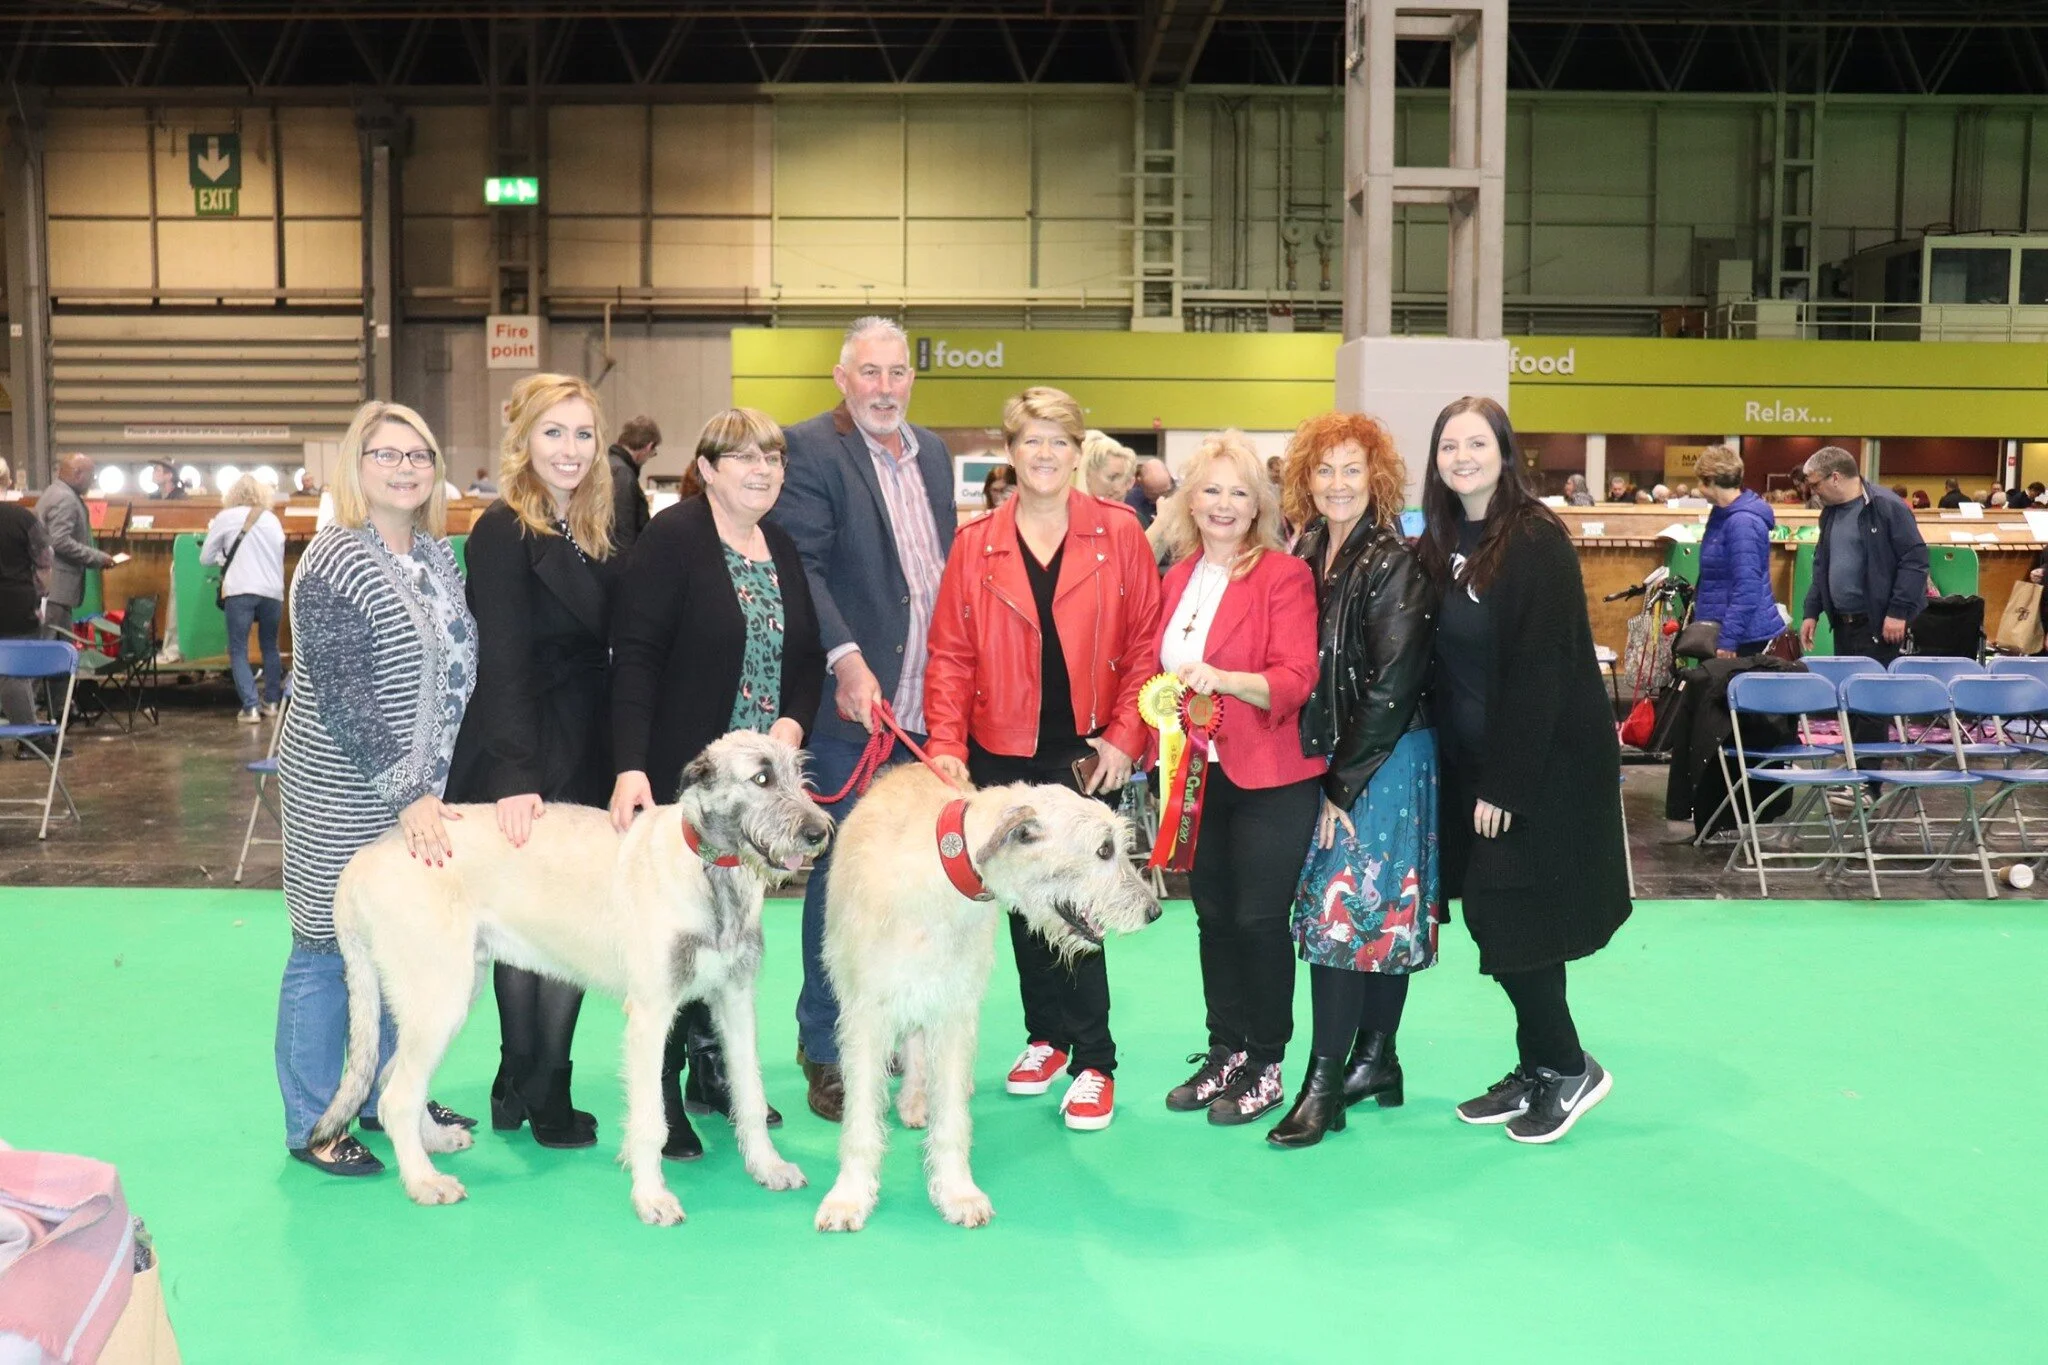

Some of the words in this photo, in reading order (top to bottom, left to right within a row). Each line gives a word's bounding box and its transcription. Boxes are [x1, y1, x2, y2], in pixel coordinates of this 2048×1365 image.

[200, 188, 232, 210] EXIT
[496, 324, 528, 338] Fire
[491, 343, 534, 358] point
[935, 340, 1003, 368] food
[1509, 346, 1574, 374] food
[1746, 400, 1832, 422] Relax...
[1179, 815, 1190, 844] 2020
